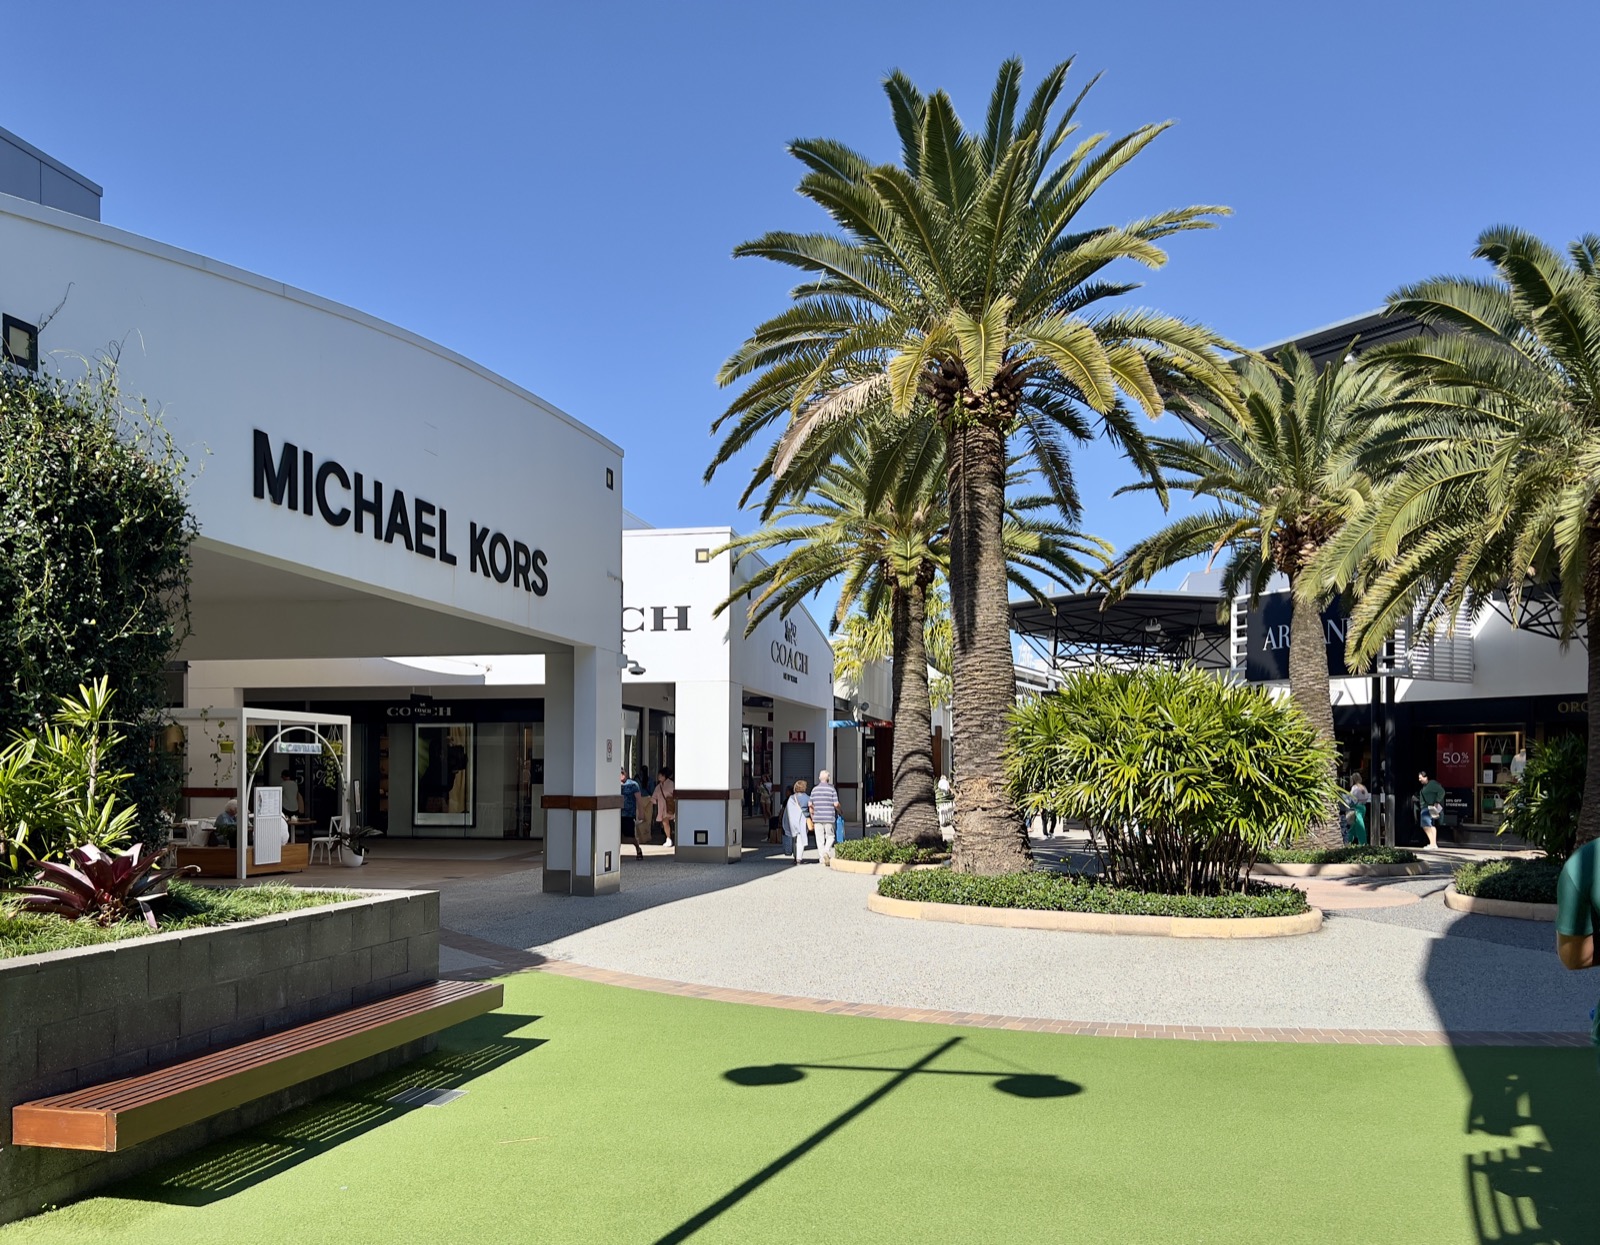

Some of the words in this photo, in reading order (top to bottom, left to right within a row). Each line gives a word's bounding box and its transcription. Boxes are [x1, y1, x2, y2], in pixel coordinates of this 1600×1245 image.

[253, 428, 457, 567] MICHAEL
[470, 521, 549, 597] KORS
[770, 640, 809, 675] COACH
[1442, 752, 1469, 764] 50%
